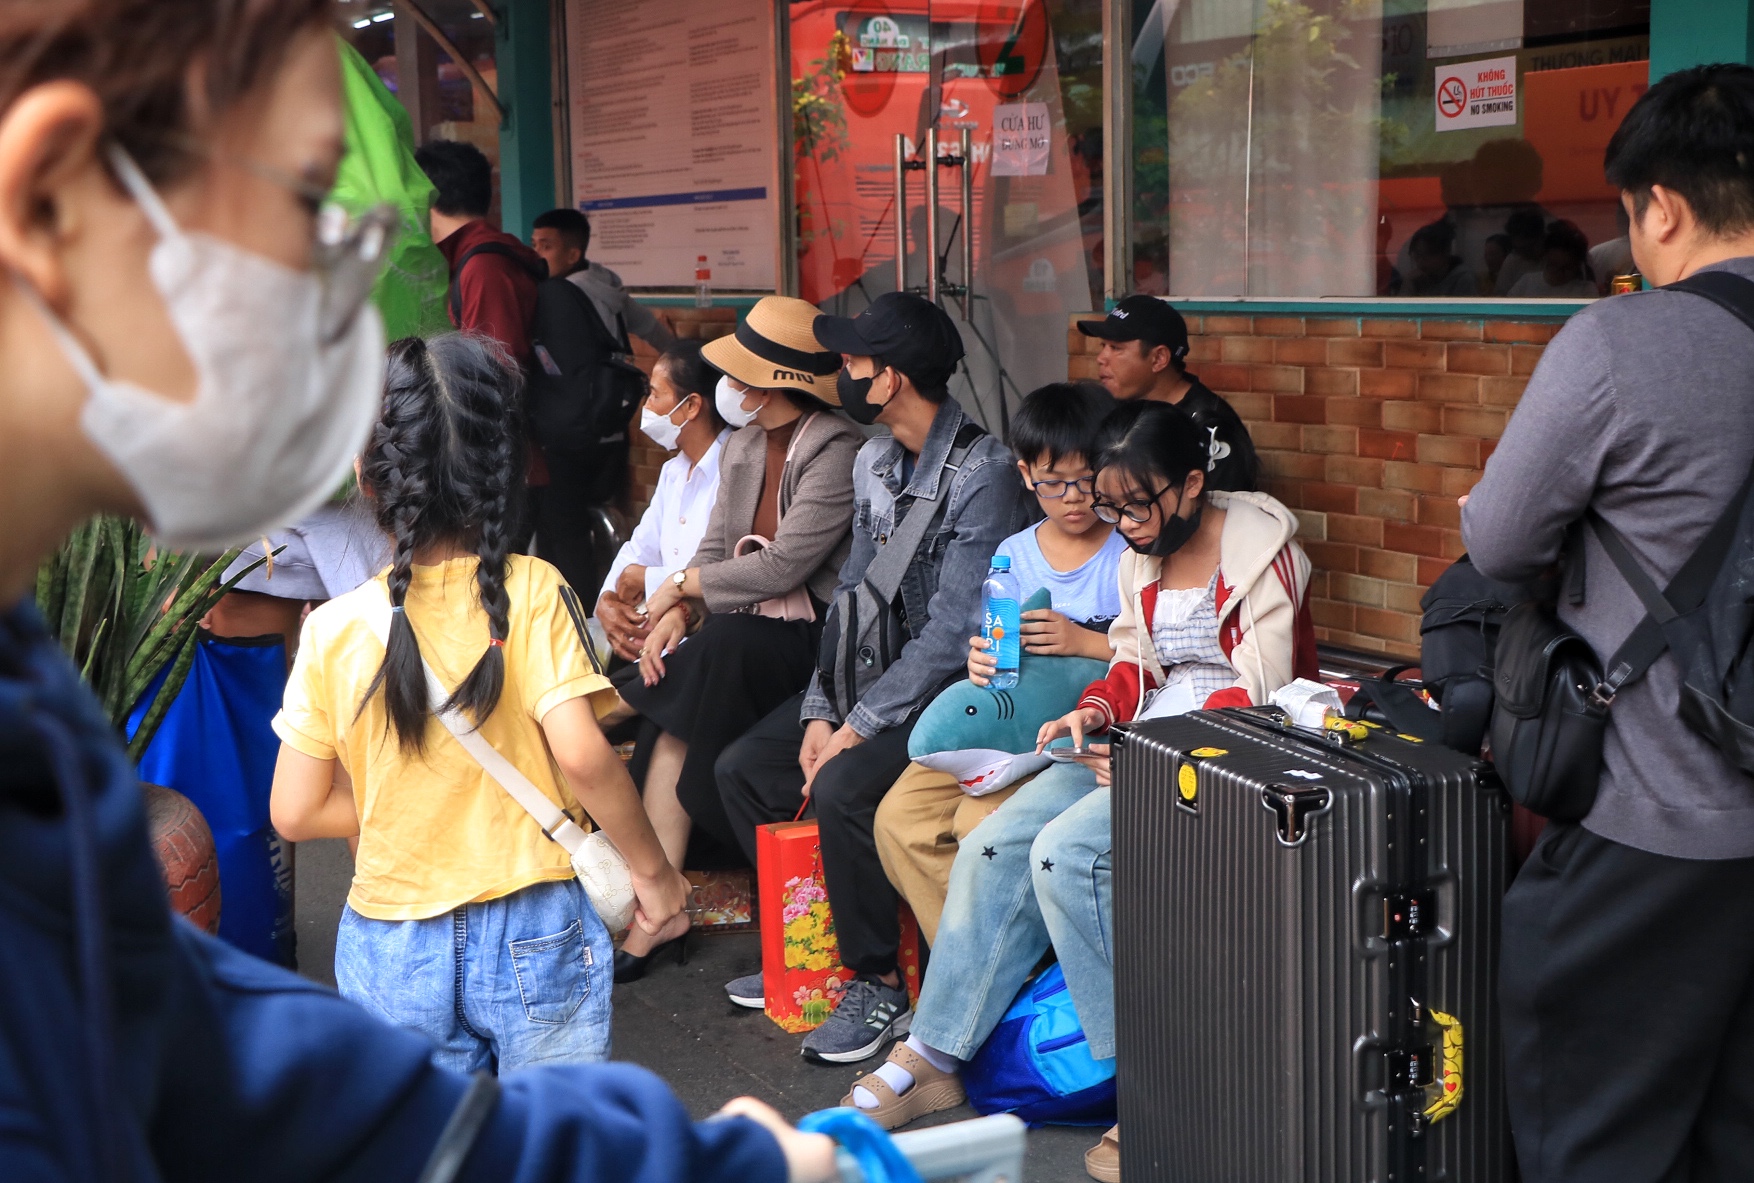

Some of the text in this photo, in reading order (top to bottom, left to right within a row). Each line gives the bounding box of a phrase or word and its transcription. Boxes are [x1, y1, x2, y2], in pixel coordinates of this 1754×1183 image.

[1477, 68, 1506, 83] KHÔNG
[1470, 81, 1514, 99] HÚT THUỐC
[1470, 101, 1513, 115] NO SMOKING
